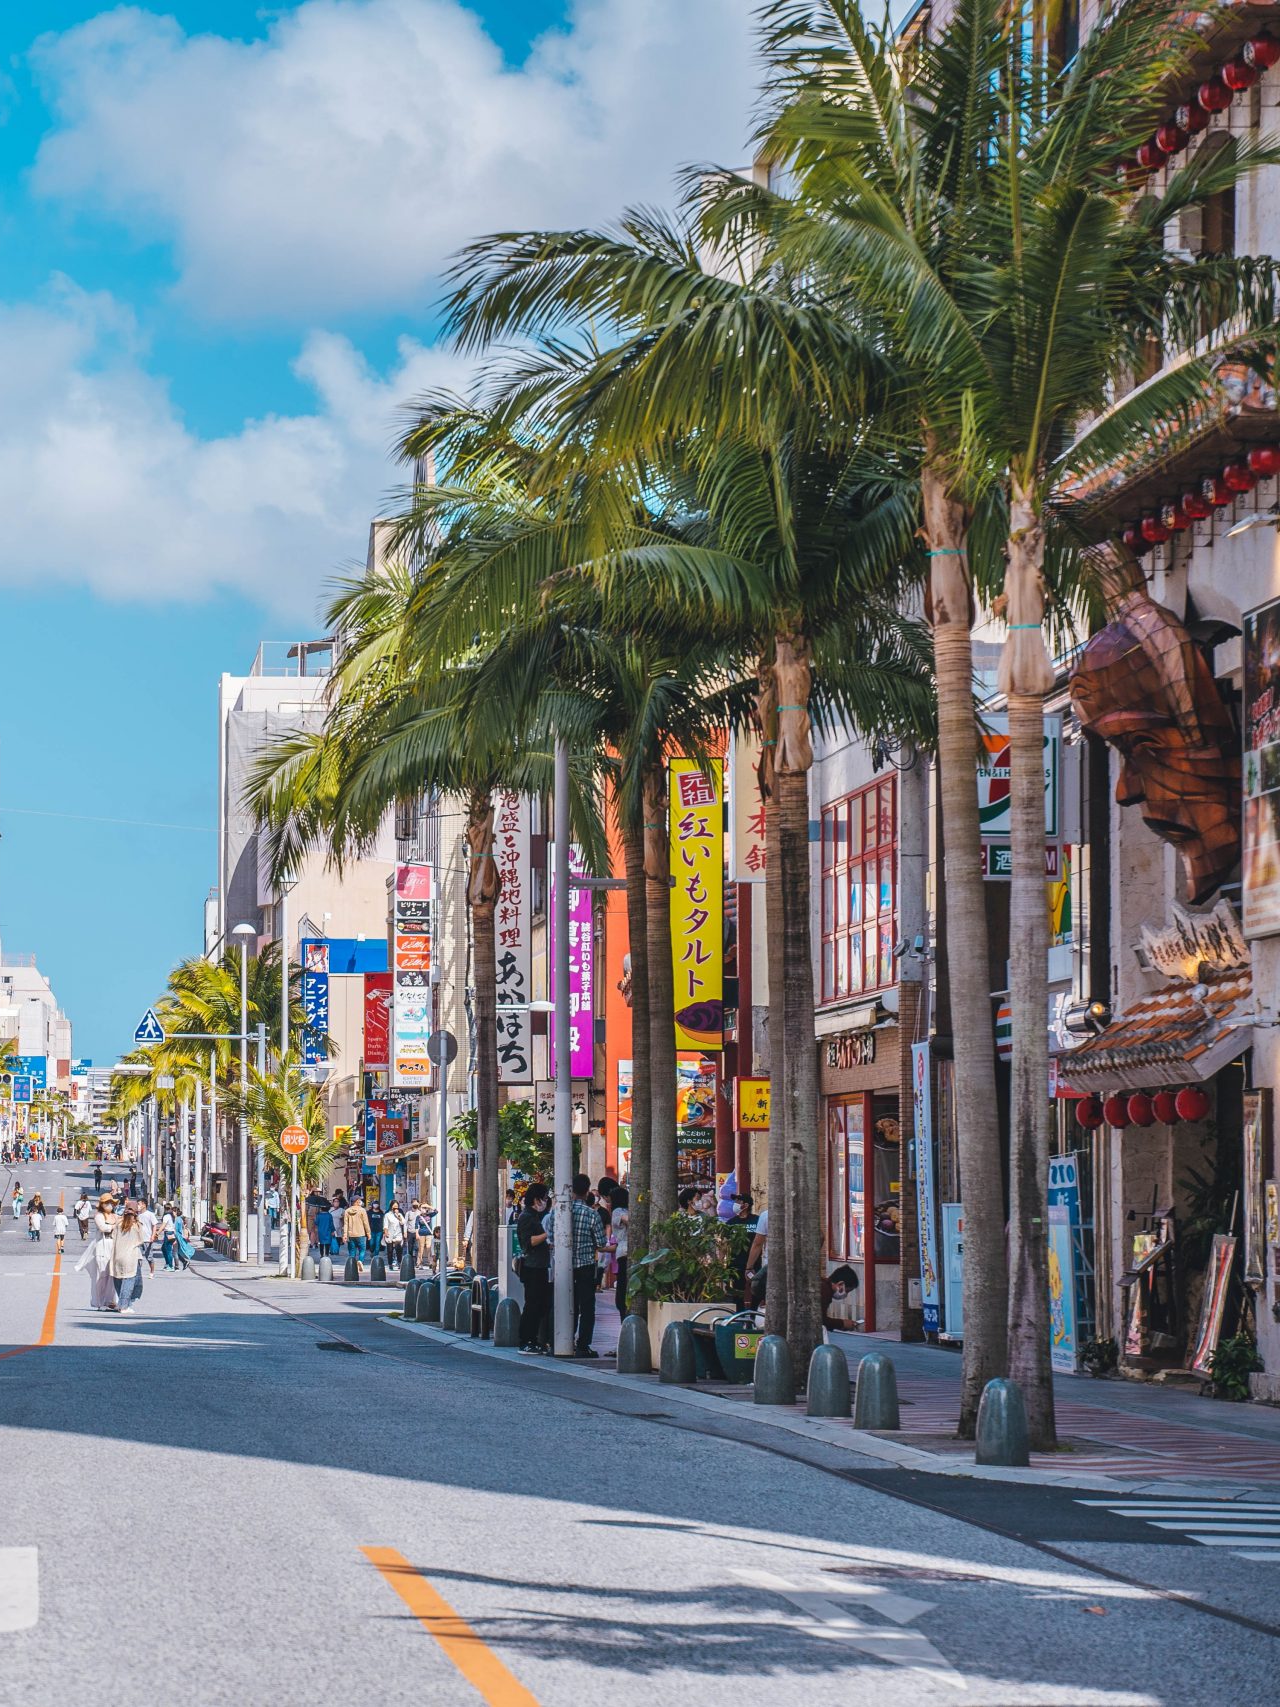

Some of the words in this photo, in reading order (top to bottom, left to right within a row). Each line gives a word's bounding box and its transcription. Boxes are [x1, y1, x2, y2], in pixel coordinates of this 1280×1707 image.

[682, 774, 713, 807] 元祖
[678, 813, 715, 999] 紅いもタルト
